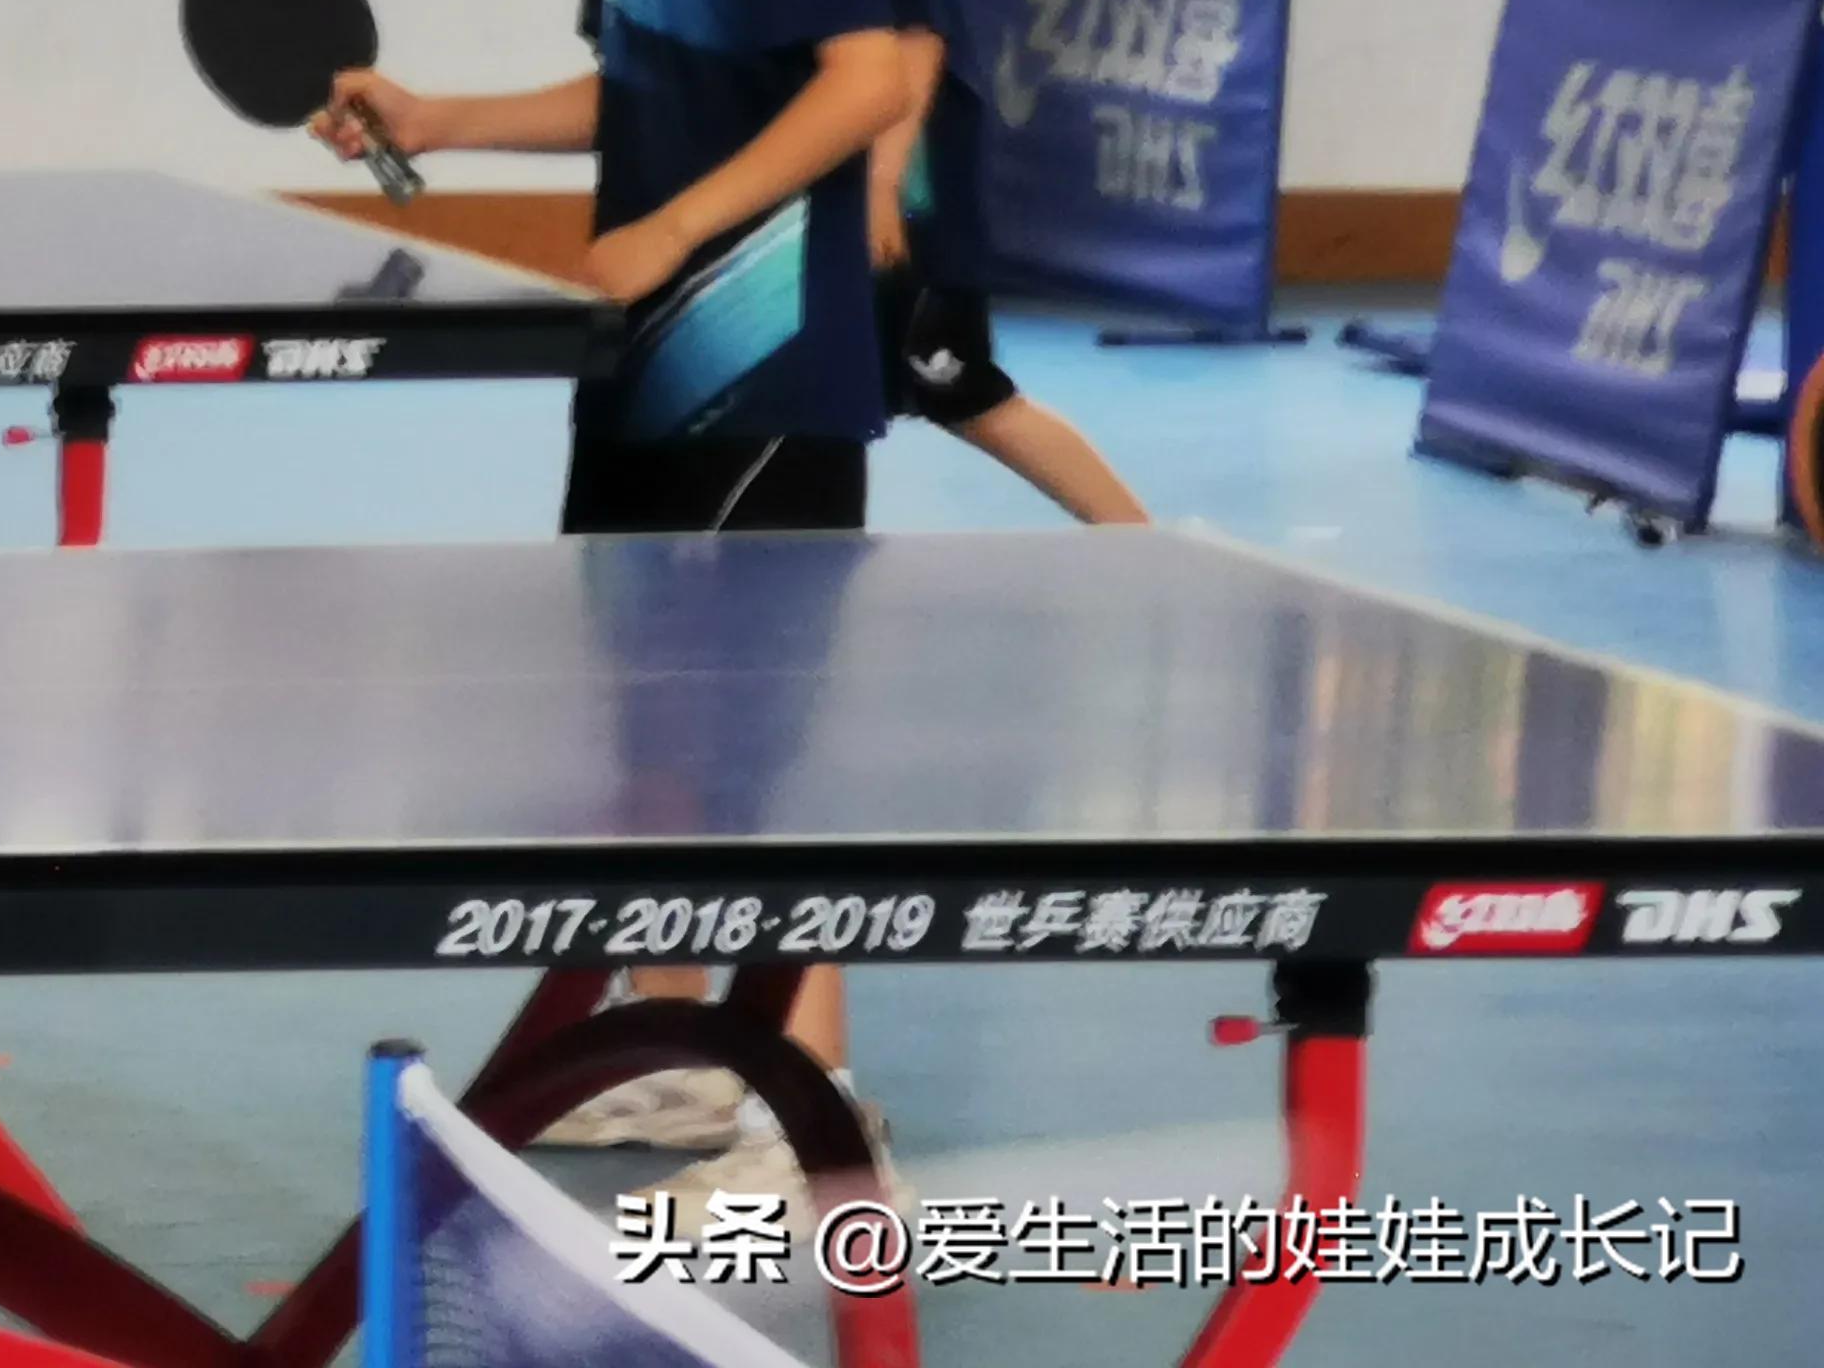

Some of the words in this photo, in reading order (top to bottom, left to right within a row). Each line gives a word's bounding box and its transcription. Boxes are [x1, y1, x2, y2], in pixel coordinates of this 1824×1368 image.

[1531, 62, 1756, 252] 红双喜
[1575, 259, 1705, 377] DHS
[961, 888, 1328, 952] 世乒赛供应商
[1615, 888, 1803, 944] DHS
